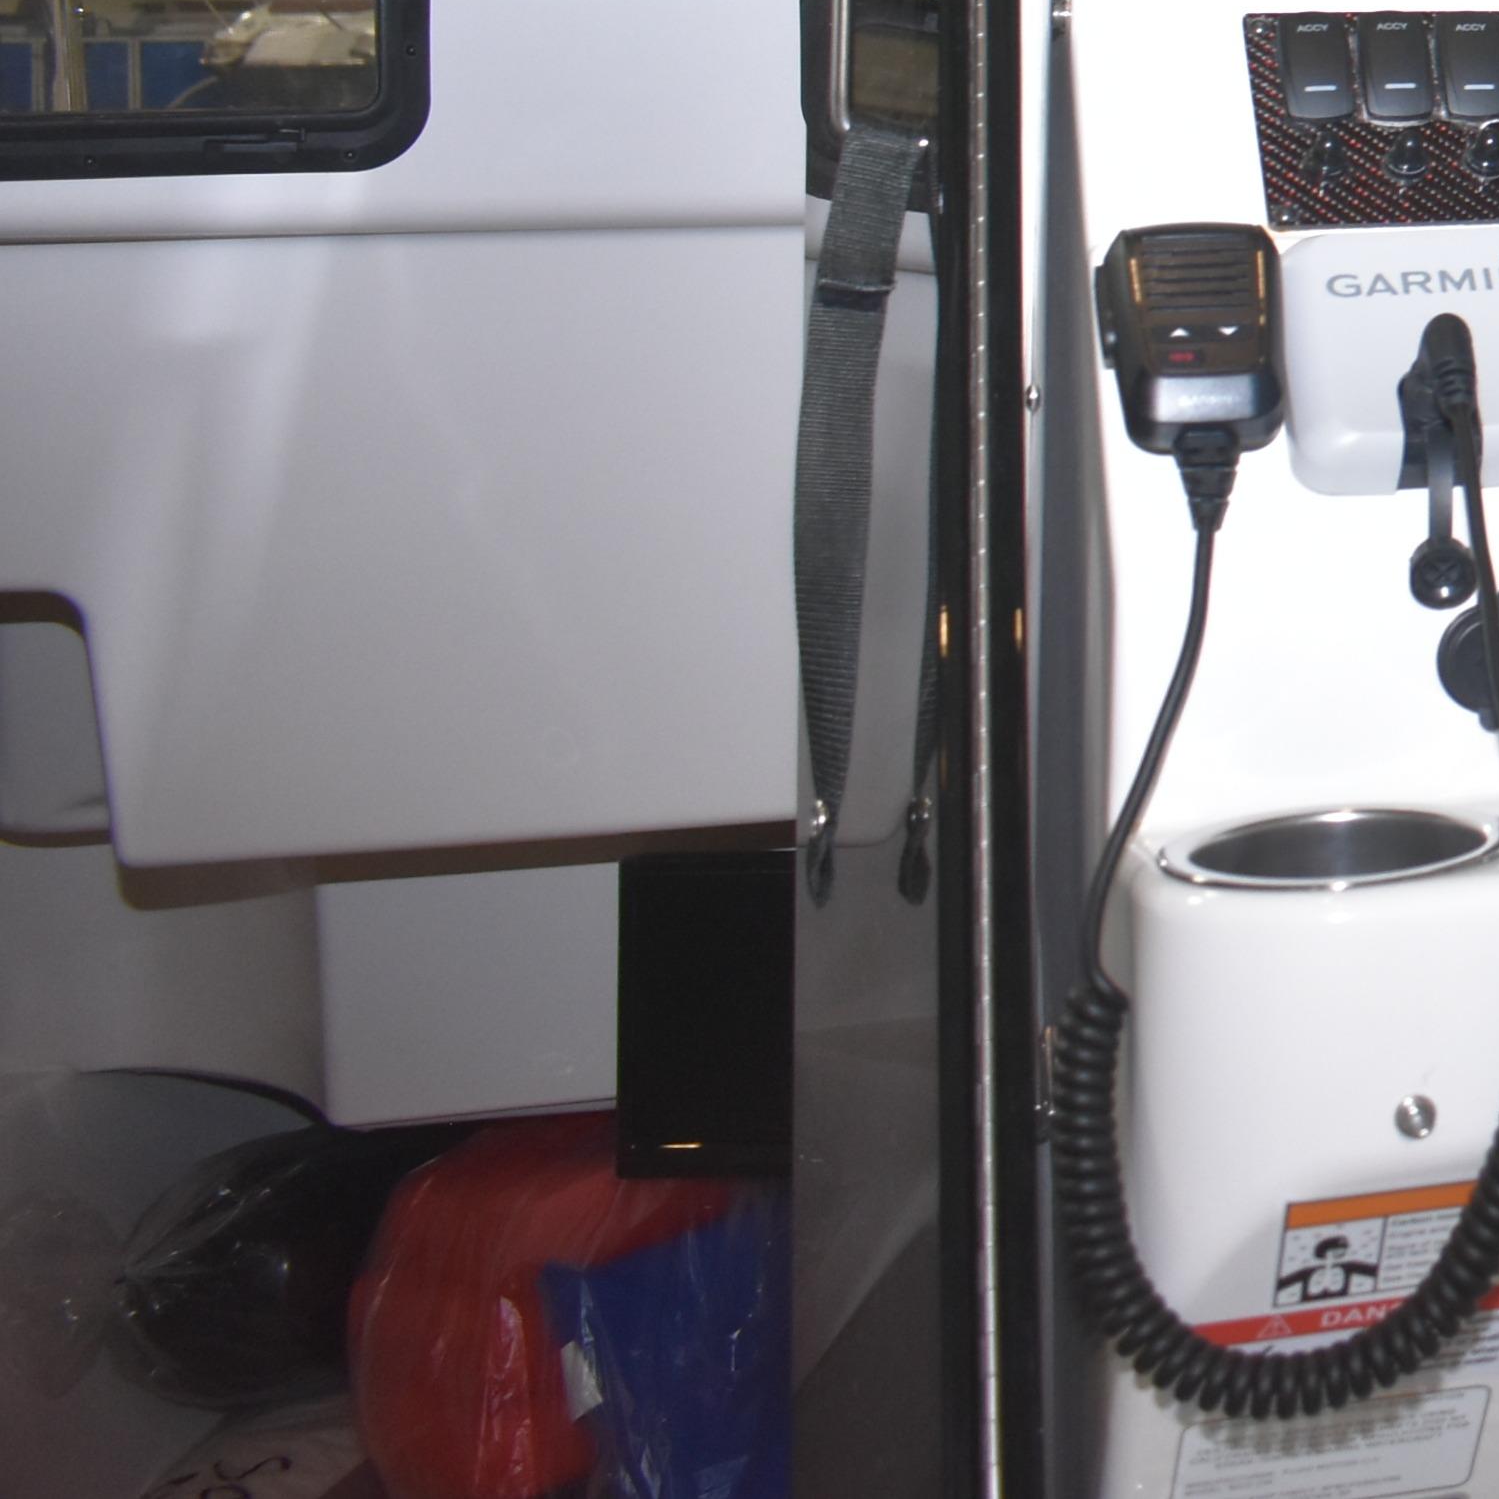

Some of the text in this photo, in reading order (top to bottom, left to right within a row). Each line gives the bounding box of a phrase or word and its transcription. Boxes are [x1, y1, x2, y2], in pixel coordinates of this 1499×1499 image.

[1296, 23, 1329, 32] ACCY
[1376, 21, 1409, 31] ACCY
[1455, 23, 1487, 32] ACCY
